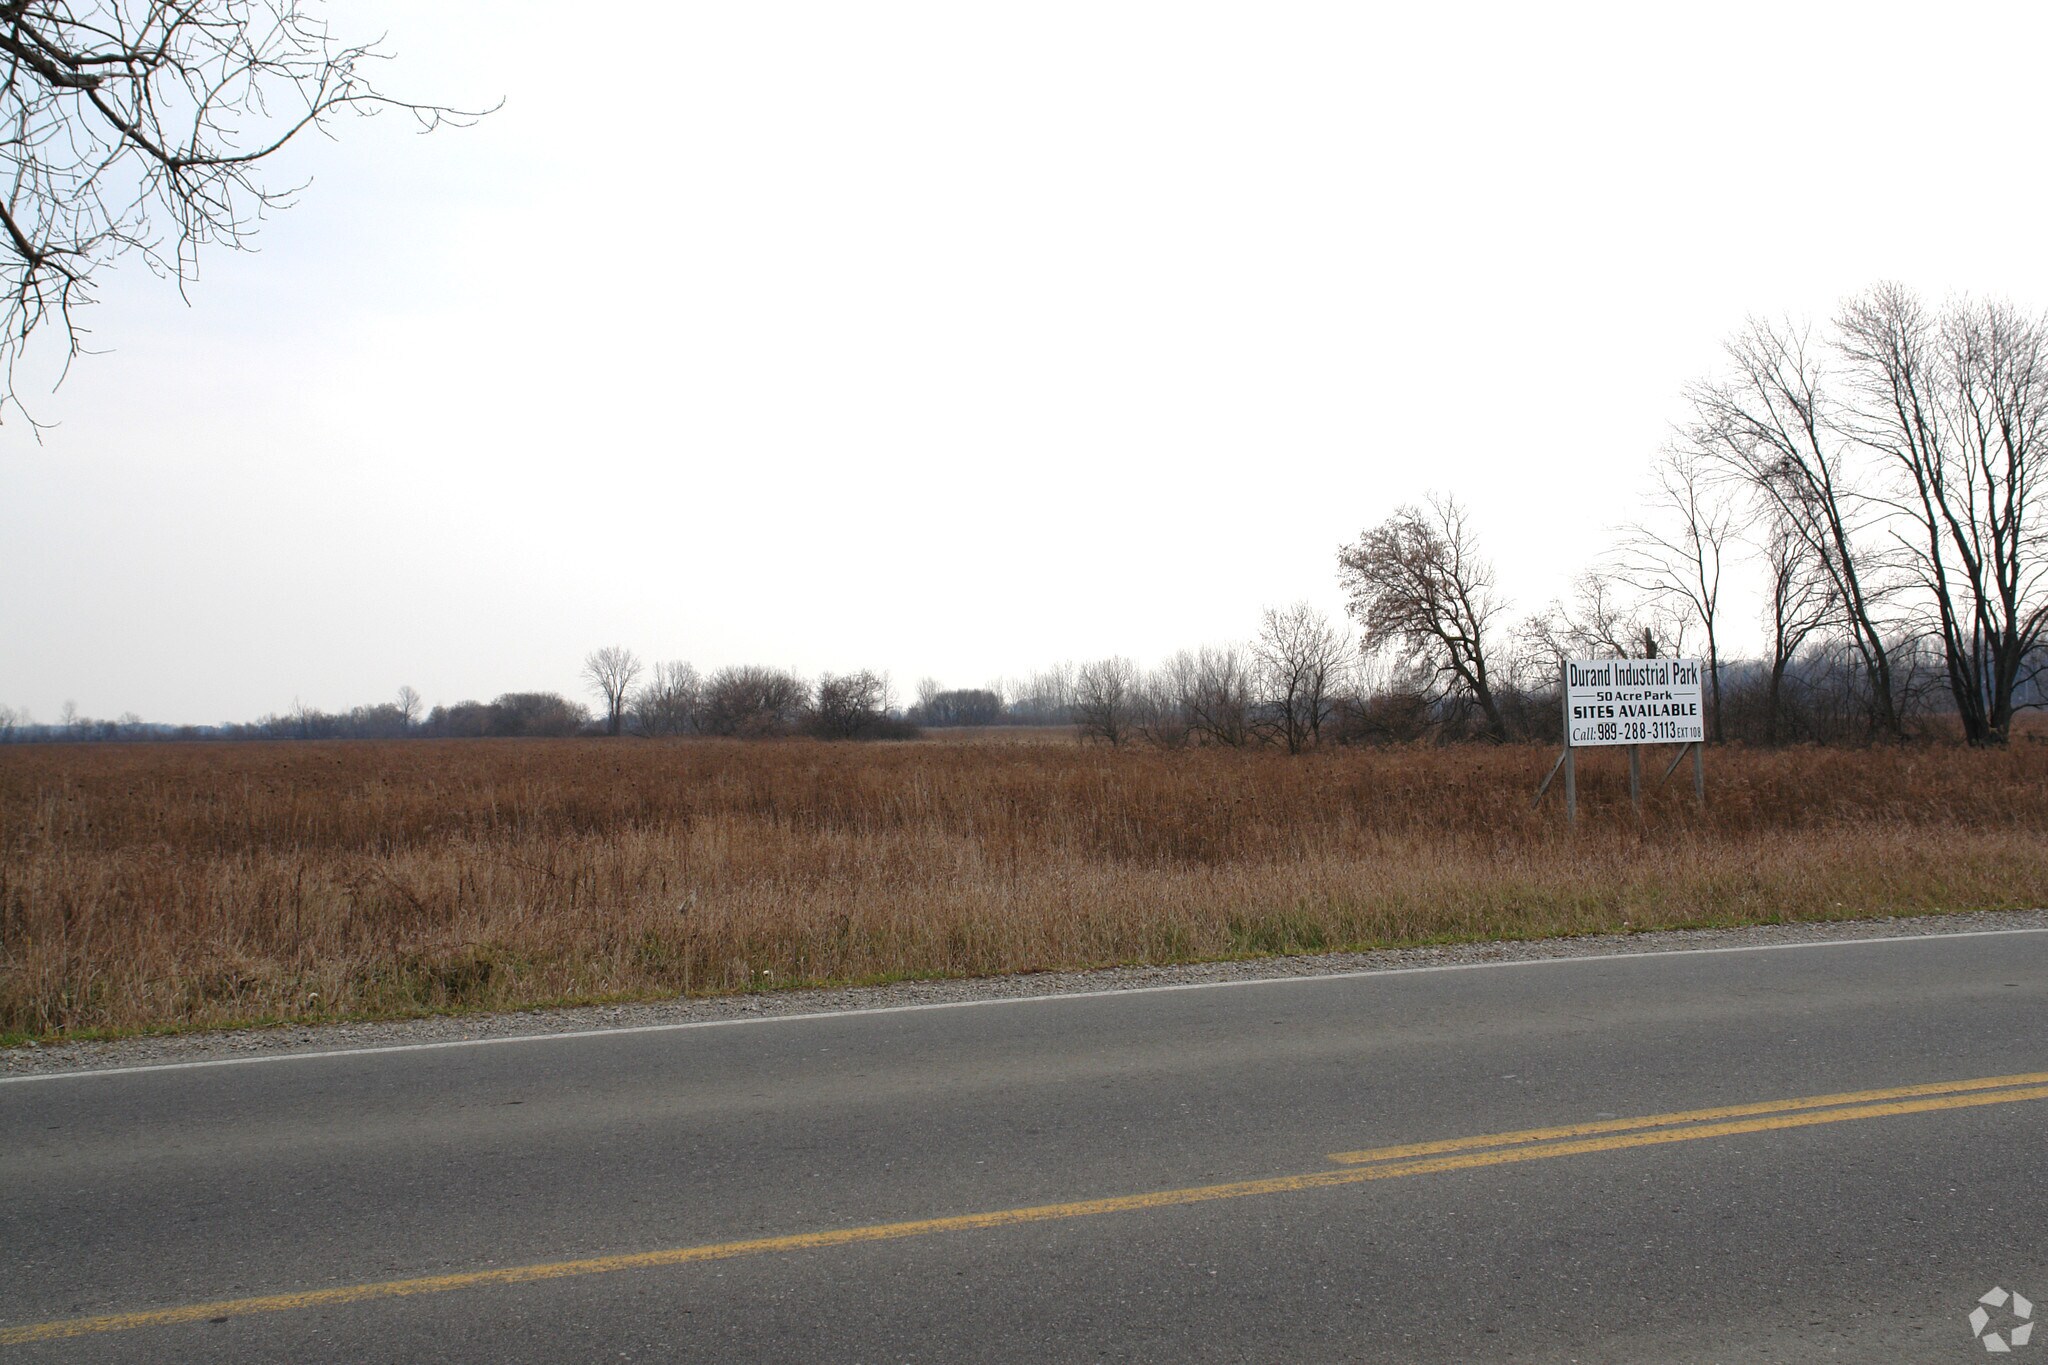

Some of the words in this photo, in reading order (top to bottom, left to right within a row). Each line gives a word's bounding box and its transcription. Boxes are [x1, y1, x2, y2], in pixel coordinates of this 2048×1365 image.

[1570, 663, 1611, 687] Durand
[1614, 662, 1669, 686] Industrial
[1673, 661, 1698, 685] Park
[1596, 691, 1613, 702] 50
[1614, 691, 1642, 701] Acre
[1644, 690, 1673, 700] Park
[1573, 705, 1614, 719] SITES
[1618, 703, 1697, 717] AVAILABLE
[1572, 727, 1597, 741] Call:
[1677, 727, 1689, 738] EXT
